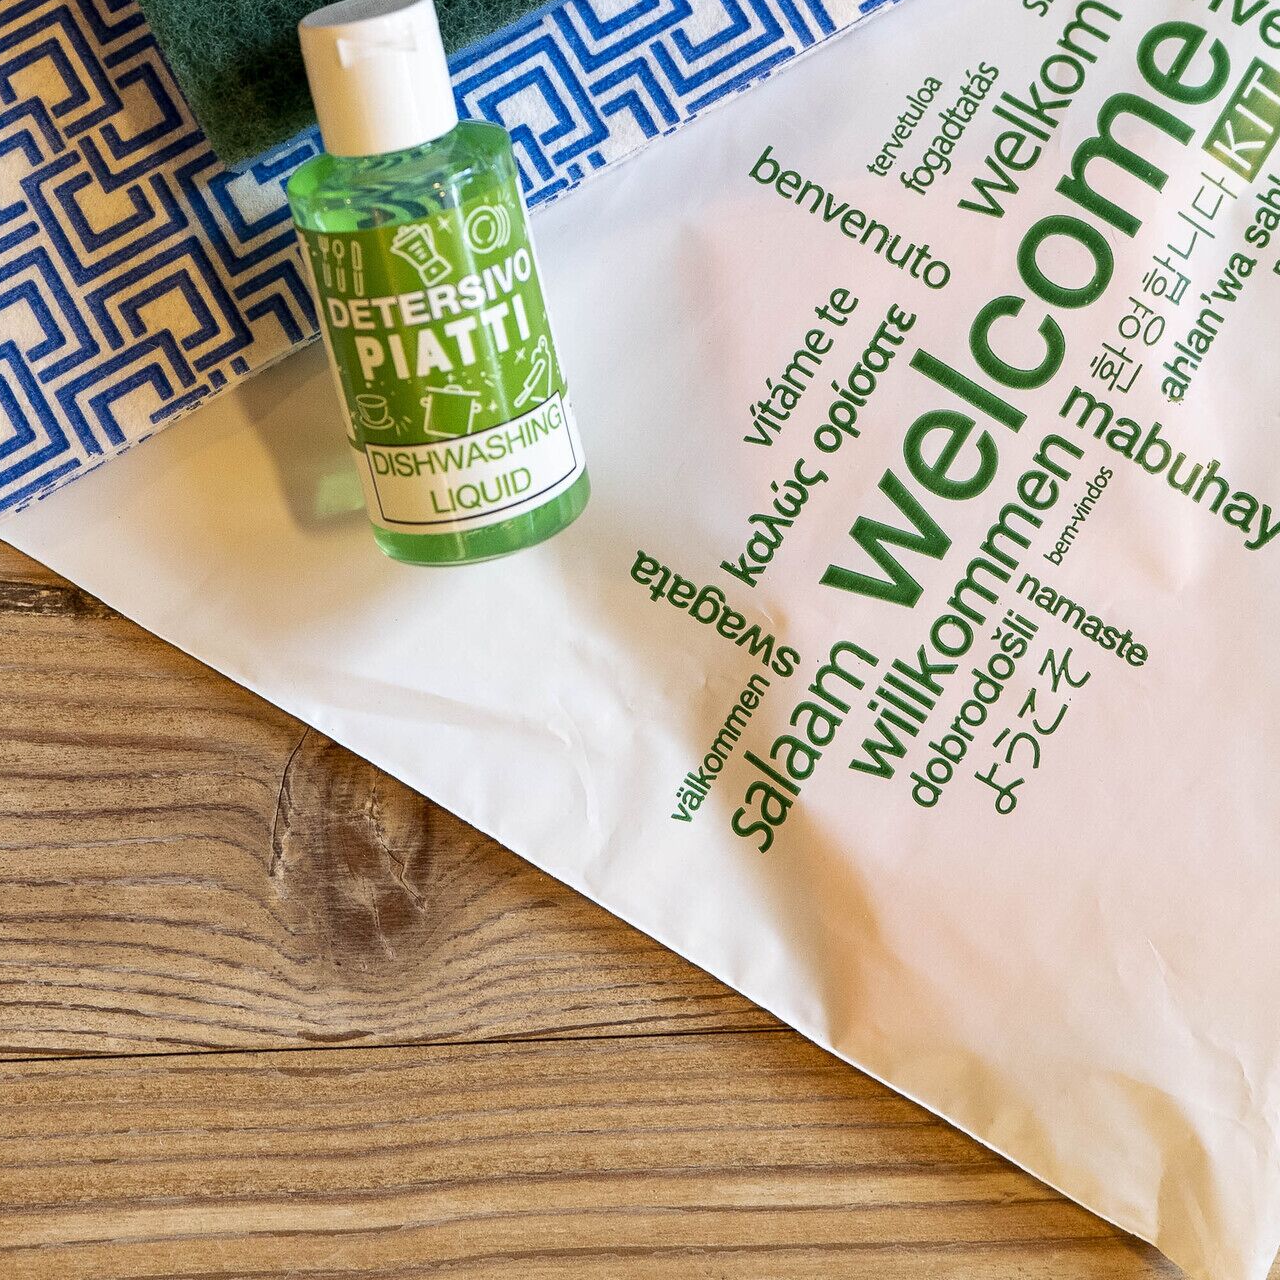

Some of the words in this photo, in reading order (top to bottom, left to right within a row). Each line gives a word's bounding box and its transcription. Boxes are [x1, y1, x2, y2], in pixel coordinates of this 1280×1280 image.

[866, 77, 943, 176] tervetuloa
[900, 62, 999, 195] fogadtatás
[749, 145, 951, 289] benvenuto
[1090, 172, 1238, 394] 환영합니다
[326, 248, 531, 331] DETERSIVO
[354, 293, 531, 381] PIATTI
[819, 12, 1230, 608] welcome
[743, 329, 834, 446] vítáme
[814, 288, 859, 326] te
[371, 403, 563, 478] DISHWASHING
[430, 467, 532, 515] LIQUID
[1043, 466, 1113, 566] bem-vindos
[631, 550, 801, 677] swagata
[849, 434, 1085, 779] willkommen
[1016, 573, 1148, 667] namaste
[671, 674, 770, 822] välkommen
[731, 642, 879, 853] salaam
[910, 609, 1039, 808] dobrodošli
[974, 647, 1091, 815] ようこそ
